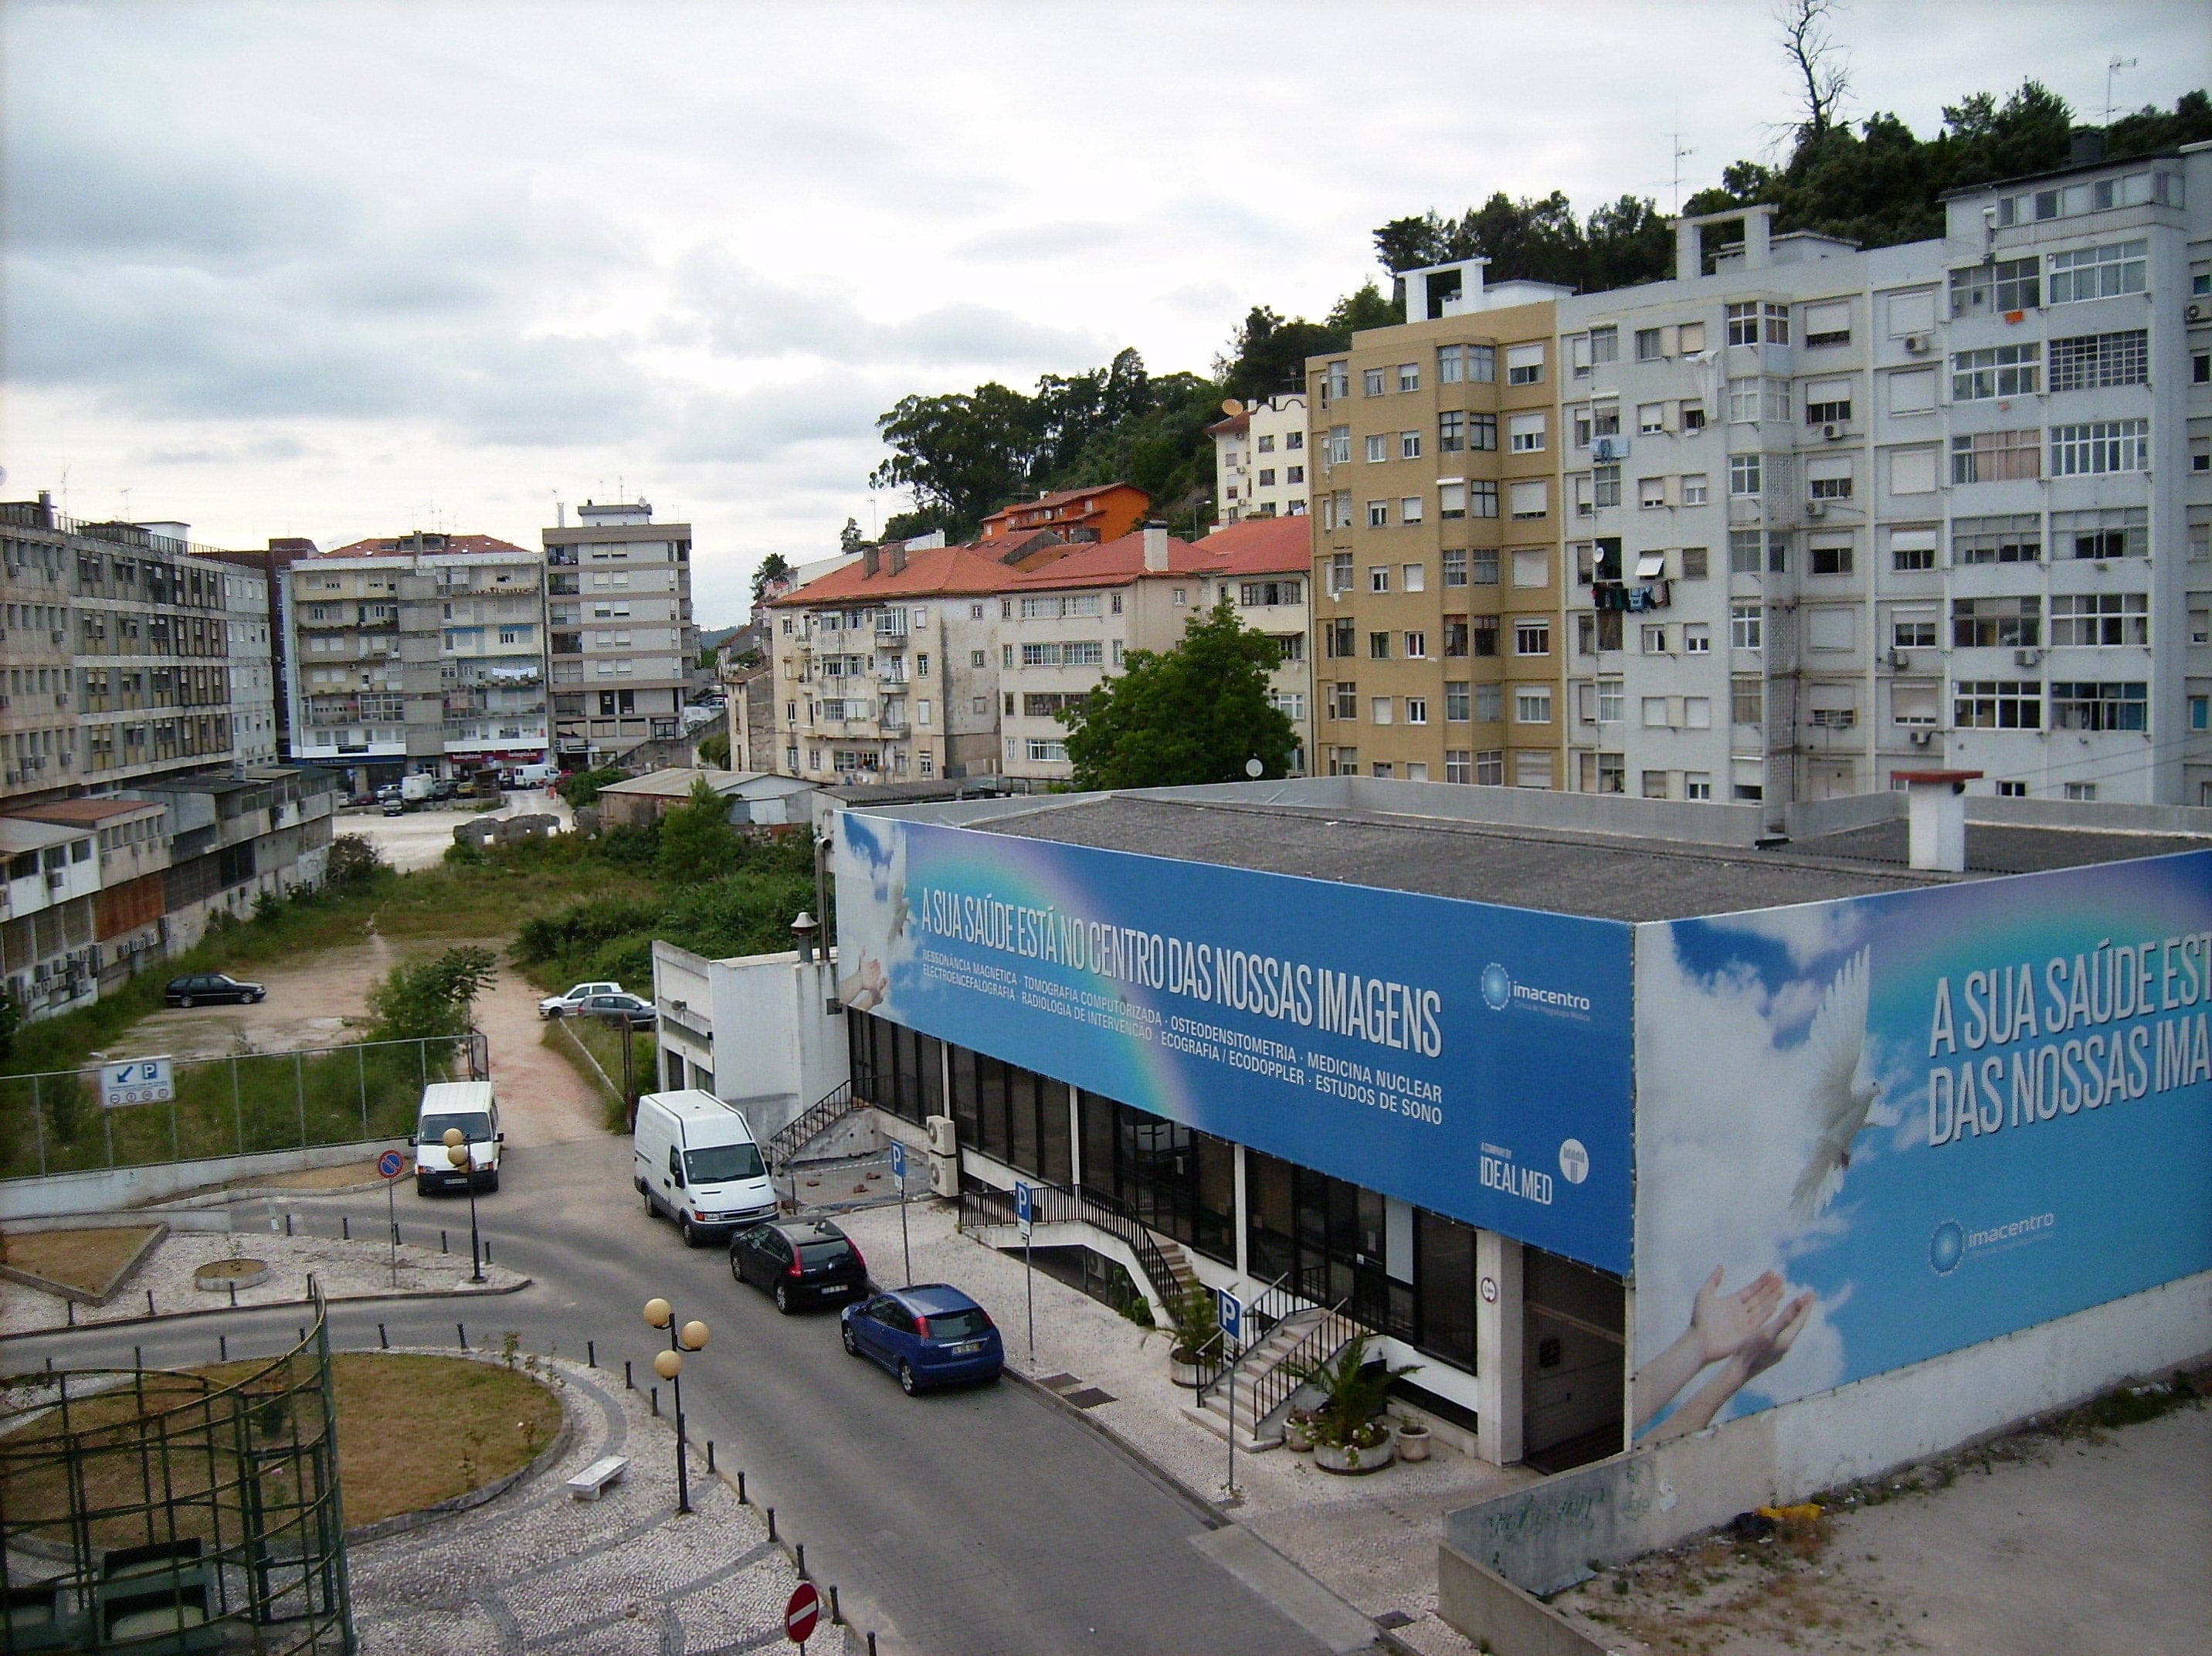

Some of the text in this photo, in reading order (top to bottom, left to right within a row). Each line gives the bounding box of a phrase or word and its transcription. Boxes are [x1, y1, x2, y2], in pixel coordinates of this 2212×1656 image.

[922, 887, 1442, 1057] A SUA SAÚDE ESTÁ NO CENTRO DAS NOSSAS IMAGENS
[1513, 980, 1590, 1010] imacentro
[1929, 976, 1956, 1058] A
[1964, 963, 2039, 1050] SUA
[2045, 938, 2156, 1033] SAÚDE
[923, 963, 1015, 1002] ELECTROENCEFALOGRAFIA
[1022, 992, 1071, 1017] RADIOLOGIA
[1074, 1006, 1086, 1022] DE
[1161, 1031, 1220, 1062] ECOGRAFIA
[1229, 1050, 1304, 1086] ECODOPPLER
[1316, 1074, 1375, 1106] ESTUDOS
[1379, 1092, 1397, 1113] DE
[1401, 1098, 1443, 1125] SONO
[1024, 976, 1079, 1003] TOMOGRAFIA
[1081, 991, 1162, 1027] COMPUTORIZADA
[1171, 1015, 1297, 1064] OSTEODENSITOMETRIA
[1307, 1051, 1372, 1084] MEDICINA
[1376, 1069, 1442, 1103] NUCLEAR
[144, 1064, 155, 1078] P
[1929, 1013, 2212, 1146] DAS NOSSAS IMA
[893, 1145, 901, 1171] P
[1018, 1186, 1027, 1213] P
[1969, 1213, 2054, 1248] imacentro
[1222, 1295, 1236, 1327] P
